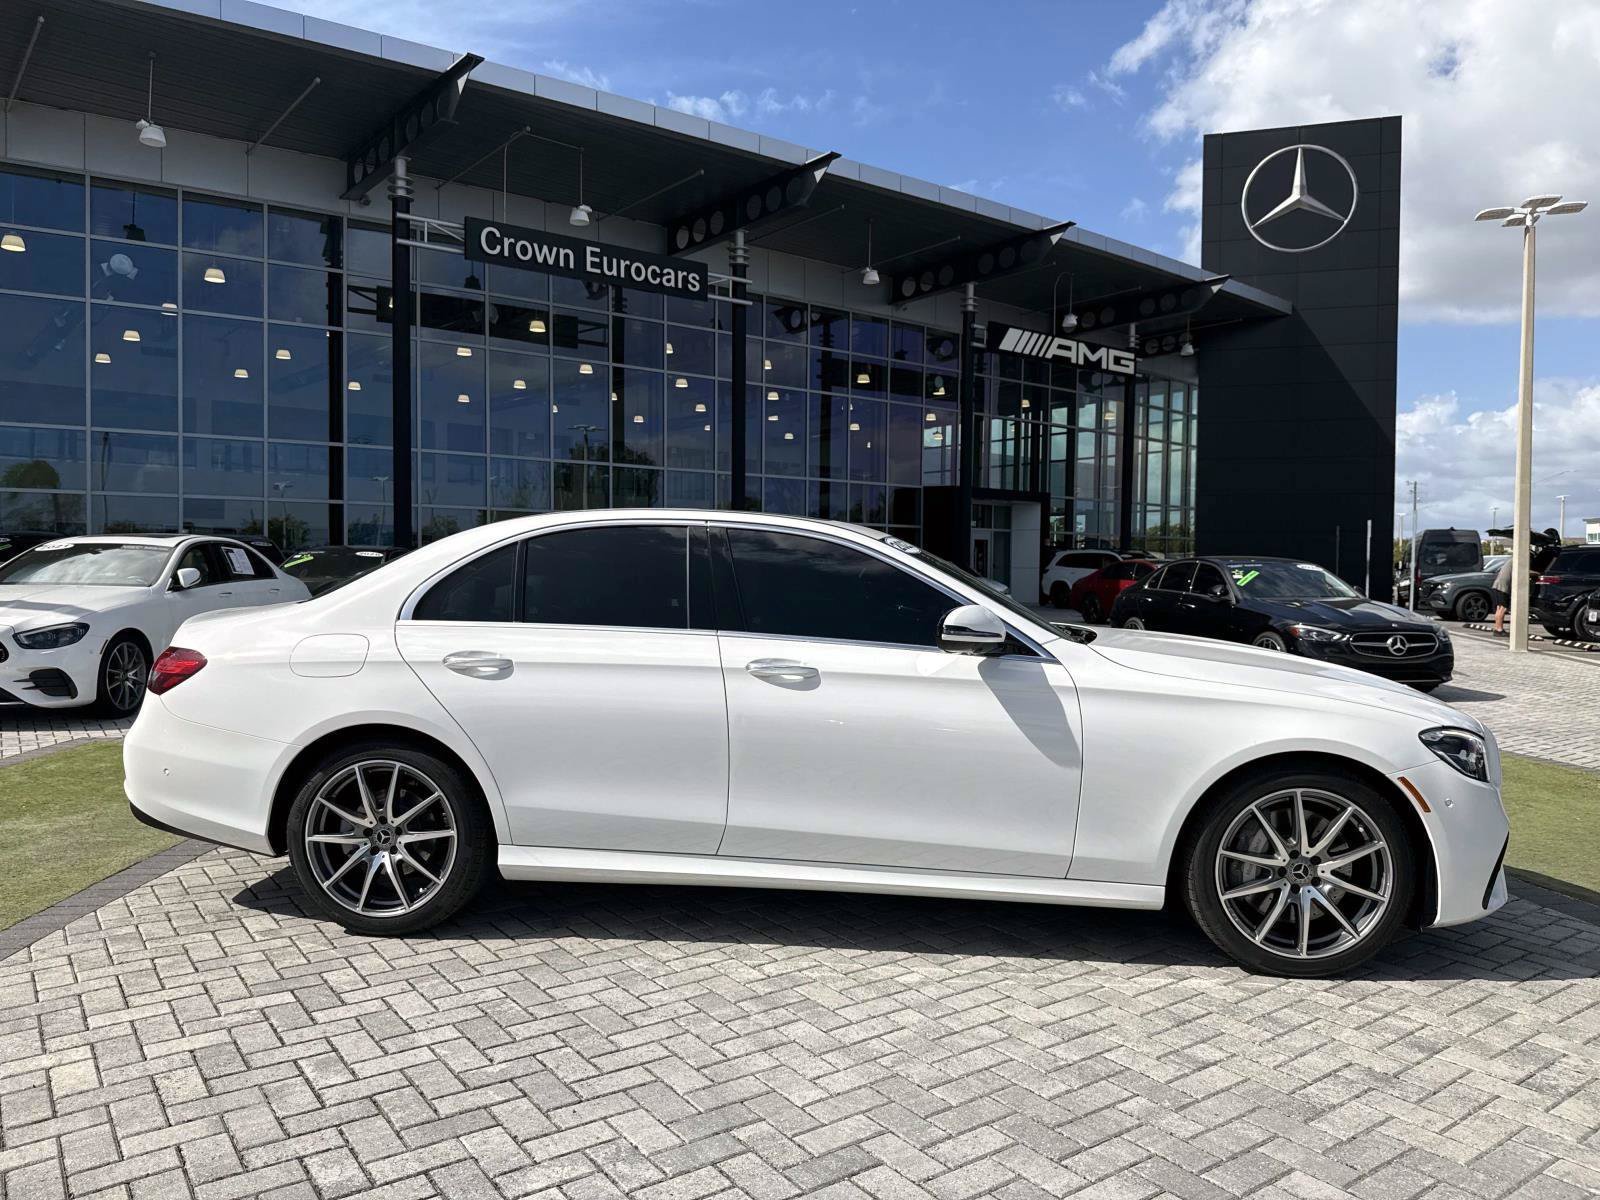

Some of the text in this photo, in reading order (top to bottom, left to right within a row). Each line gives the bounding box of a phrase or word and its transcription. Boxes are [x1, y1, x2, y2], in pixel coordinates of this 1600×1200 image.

[480, 226, 700, 292] Crown Eurocars
[1044, 337, 1135, 375] AMG
